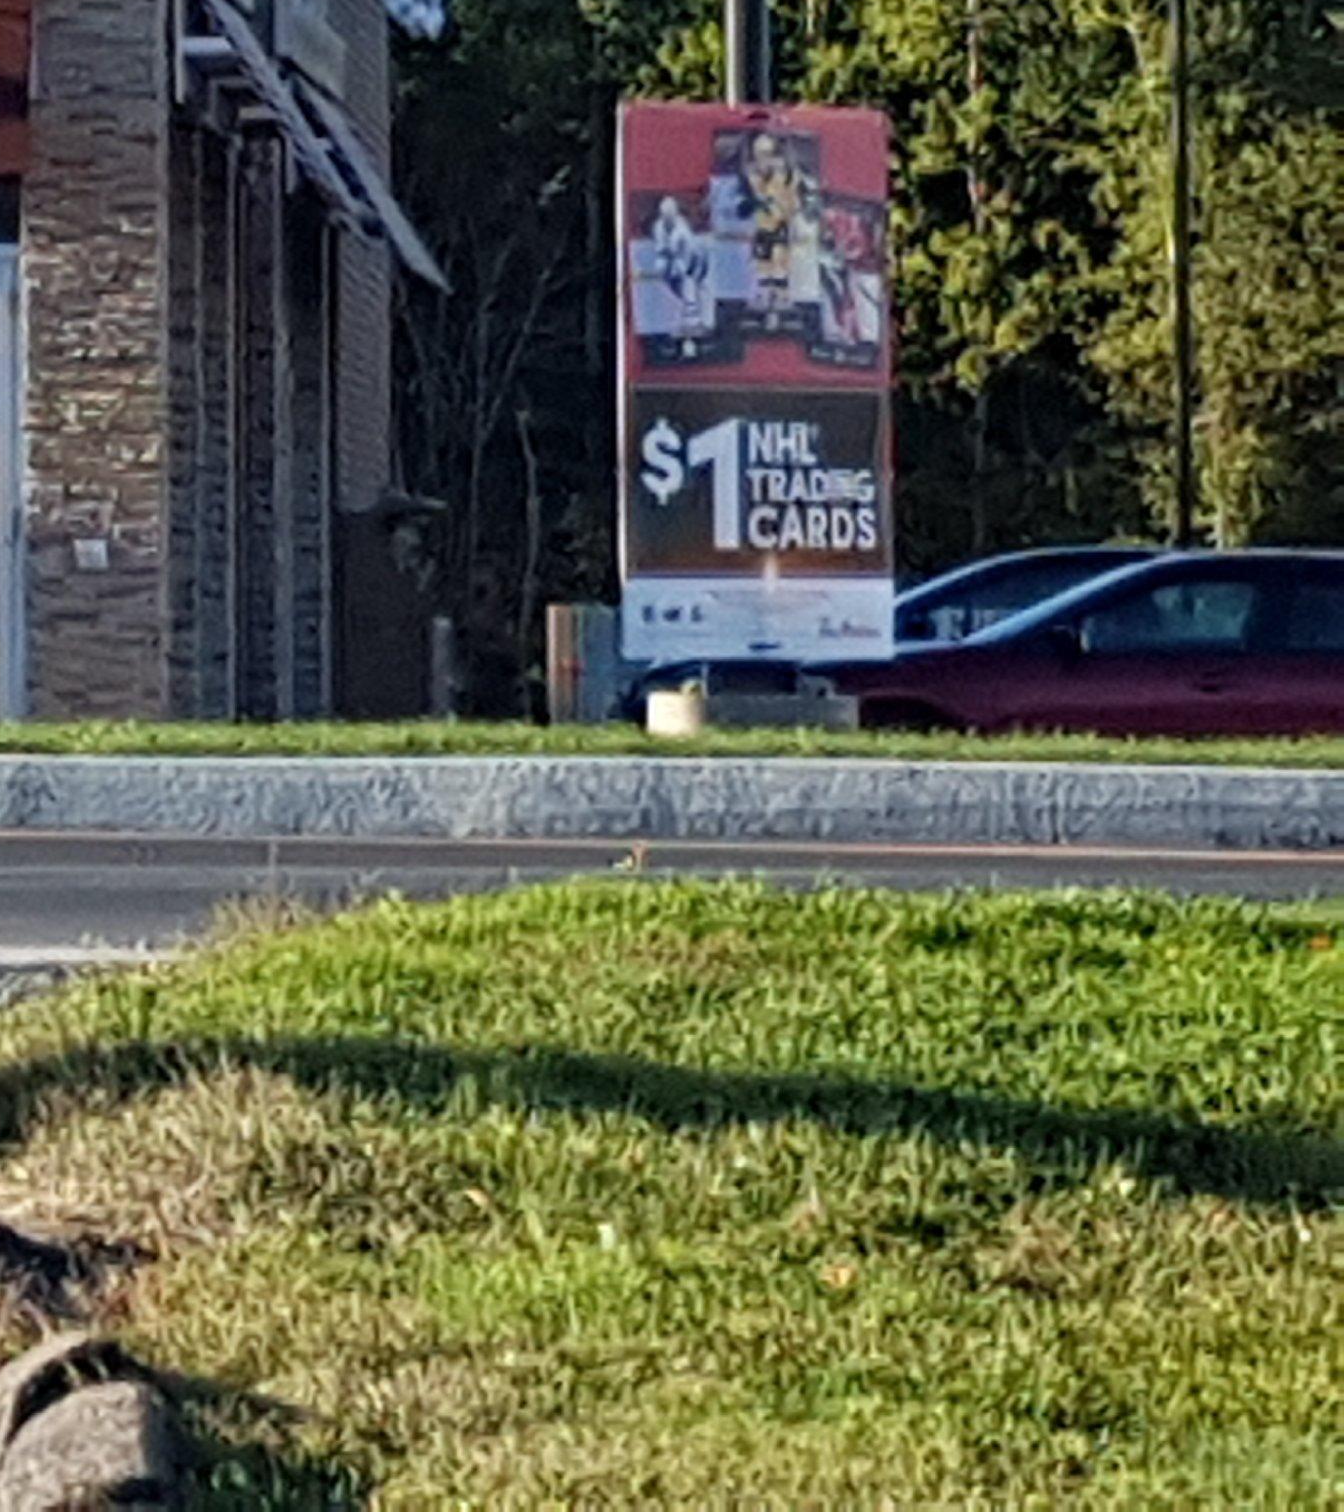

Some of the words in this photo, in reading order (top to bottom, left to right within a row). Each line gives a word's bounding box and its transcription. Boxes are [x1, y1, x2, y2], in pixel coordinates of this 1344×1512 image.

[747, 421, 817, 465] NHL
[641, 416, 740, 549] $1
[747, 469, 875, 502] TRADING
[748, 507, 877, 549] CARDS
